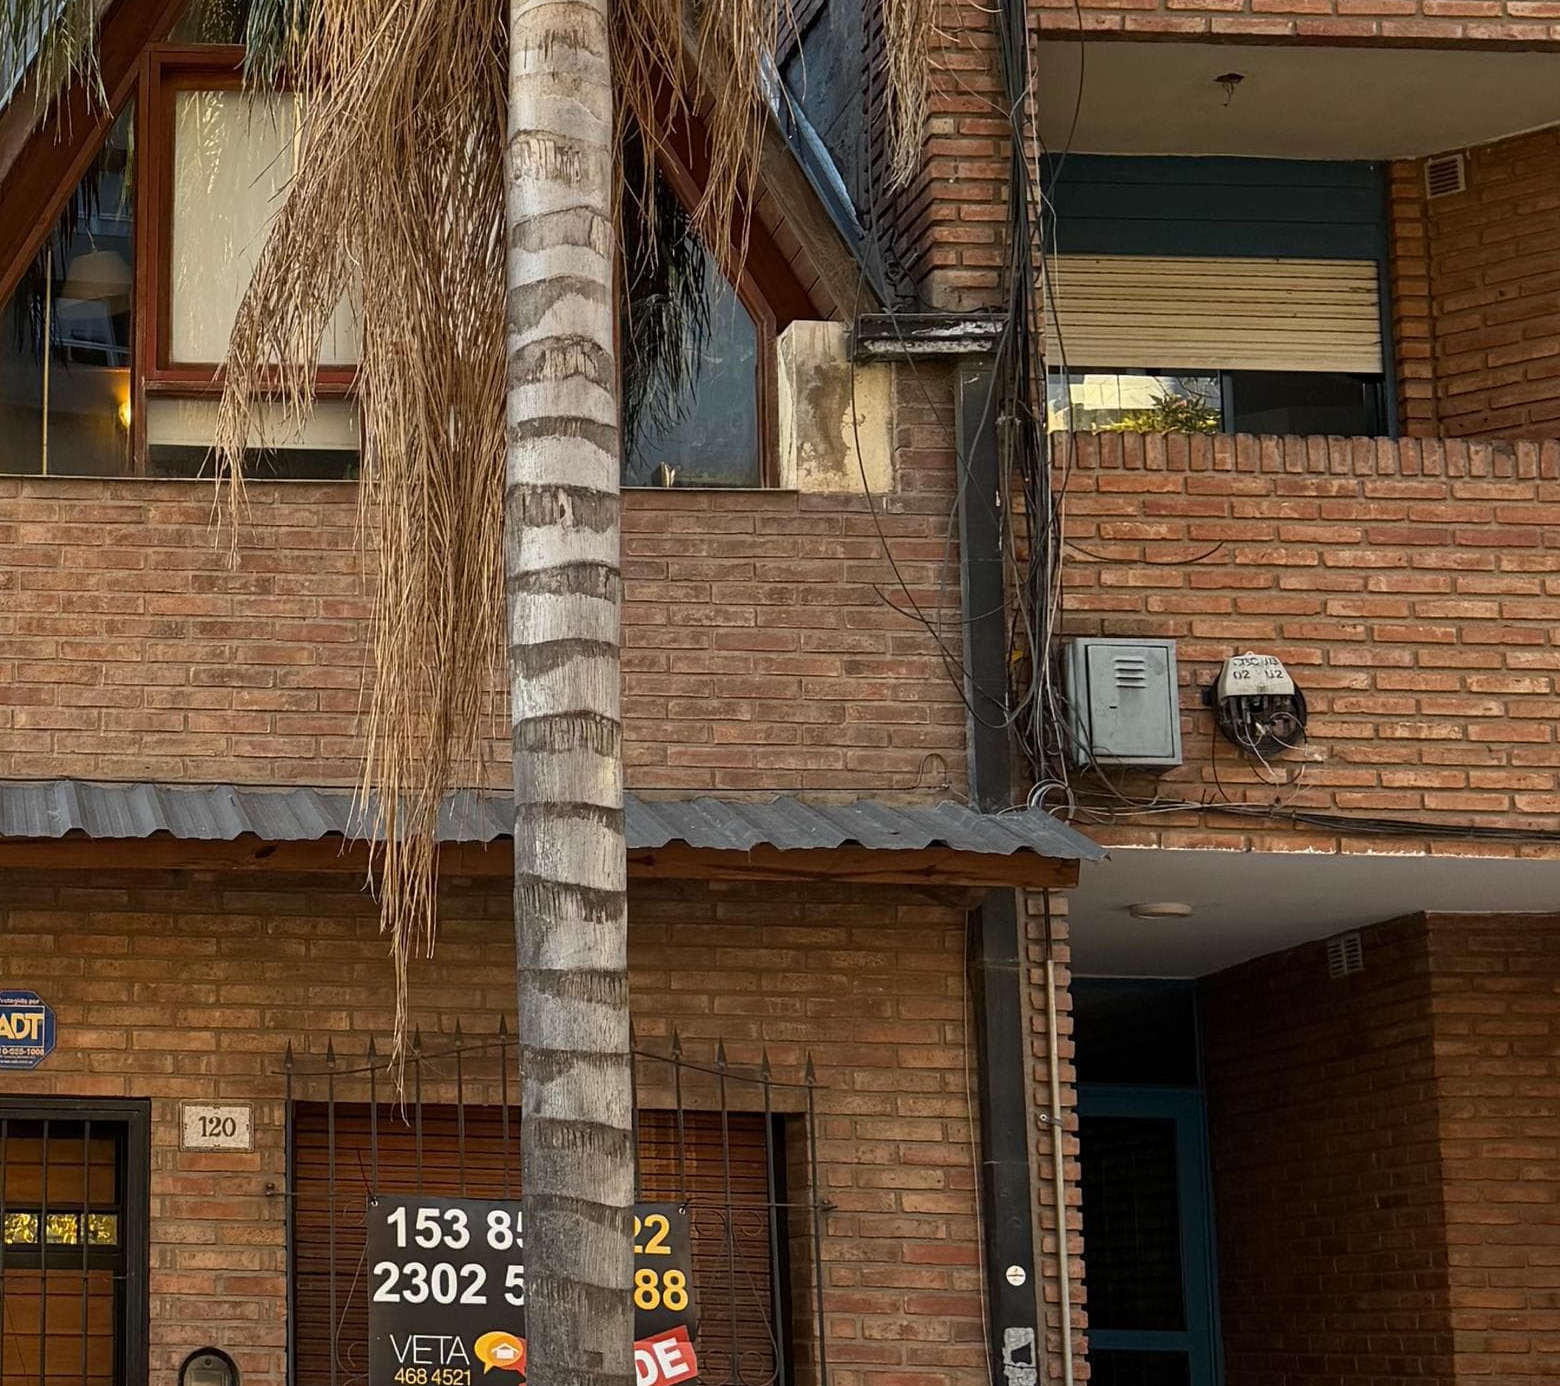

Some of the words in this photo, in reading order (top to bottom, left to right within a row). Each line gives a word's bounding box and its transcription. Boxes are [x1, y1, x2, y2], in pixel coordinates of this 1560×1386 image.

[198, 1116, 237, 1137] 120
[387, 1206, 470, 1249] 153
[486, 1209, 524, 1251] 8
[373, 1261, 488, 1305] 2302
[389, 1334, 470, 1365] VETA
[394, 1366, 428, 1384] 468
[431, 1368, 471, 1386] 4521
